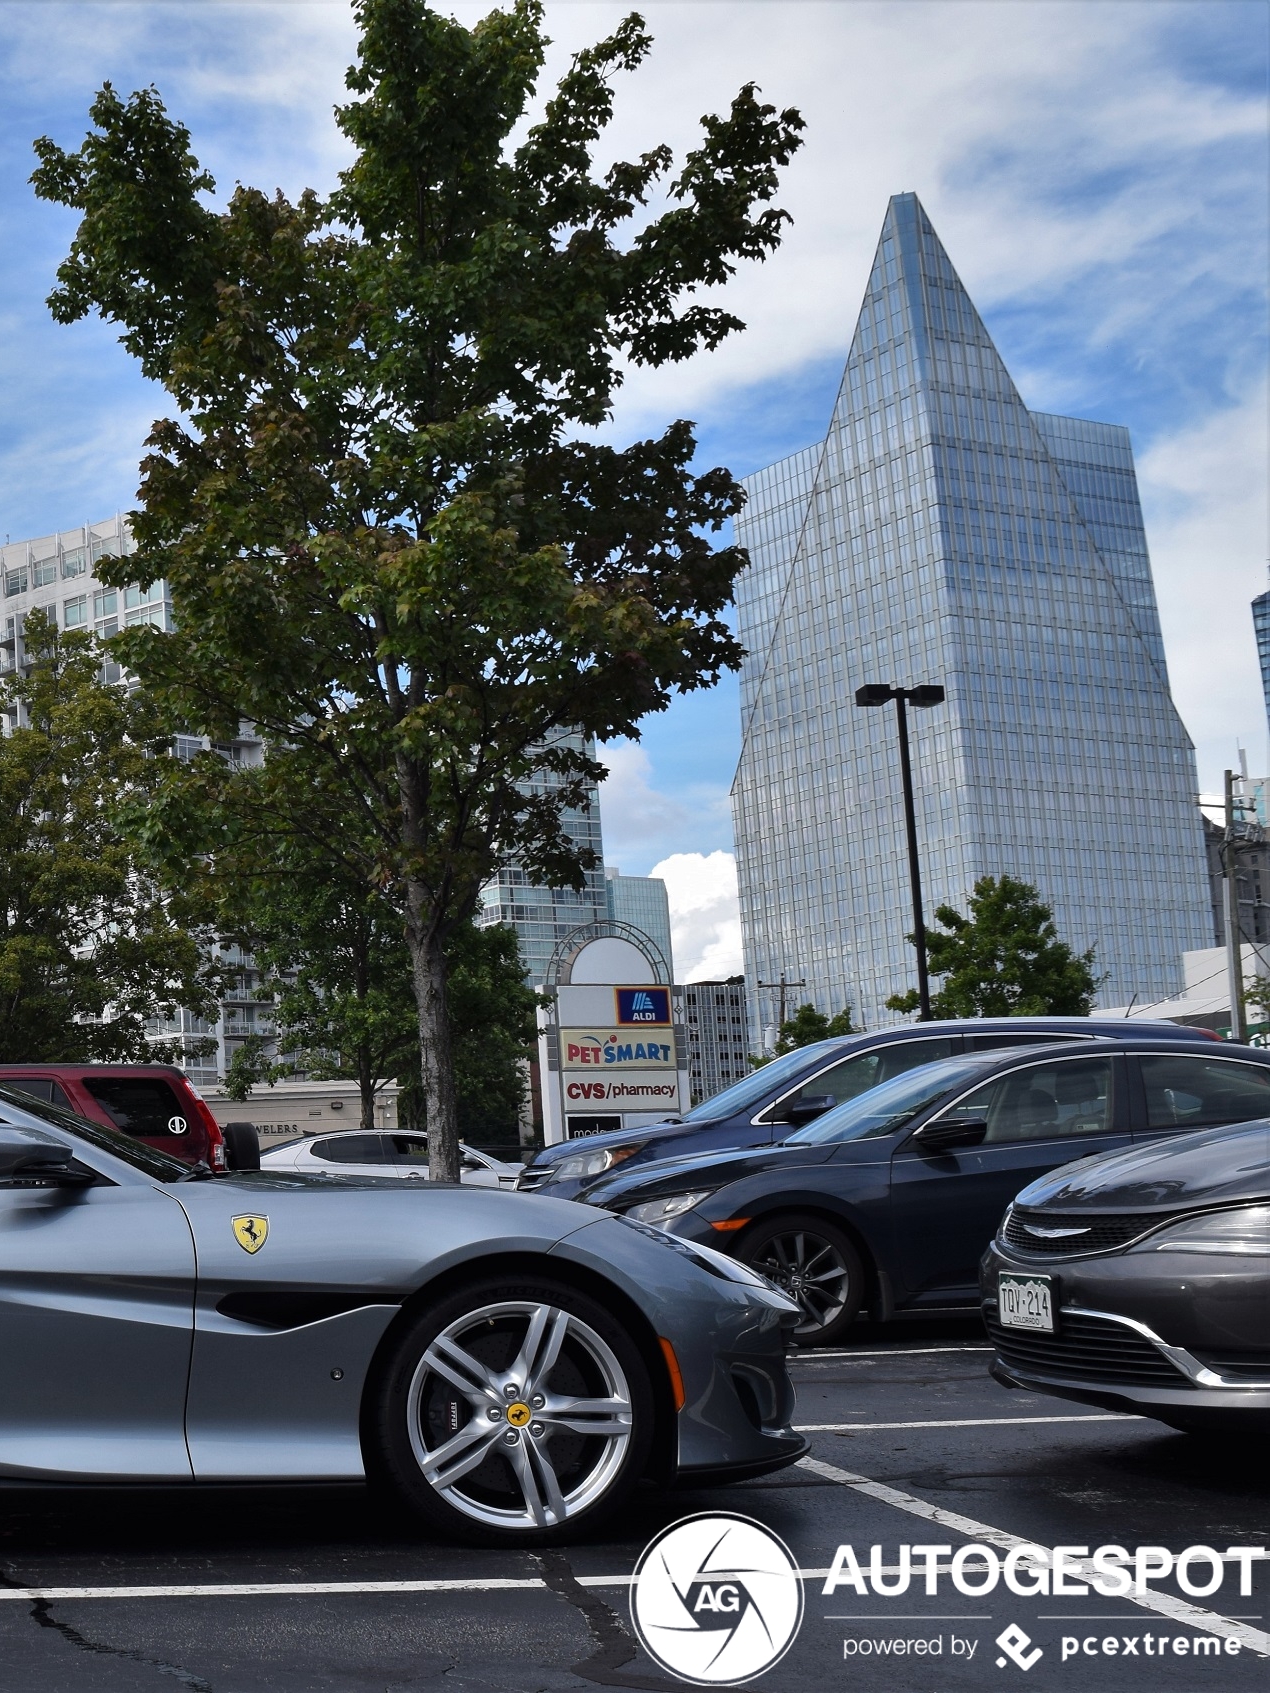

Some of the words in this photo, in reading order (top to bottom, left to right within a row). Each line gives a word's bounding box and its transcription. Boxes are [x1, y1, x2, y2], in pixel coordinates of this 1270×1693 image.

[632, 1012, 656, 1021] ALDI
[567, 1043, 671, 1064] PETSMART
[255, 1124, 298, 1134] WELERS
[1013, 1315, 1040, 1325] COLORADO
